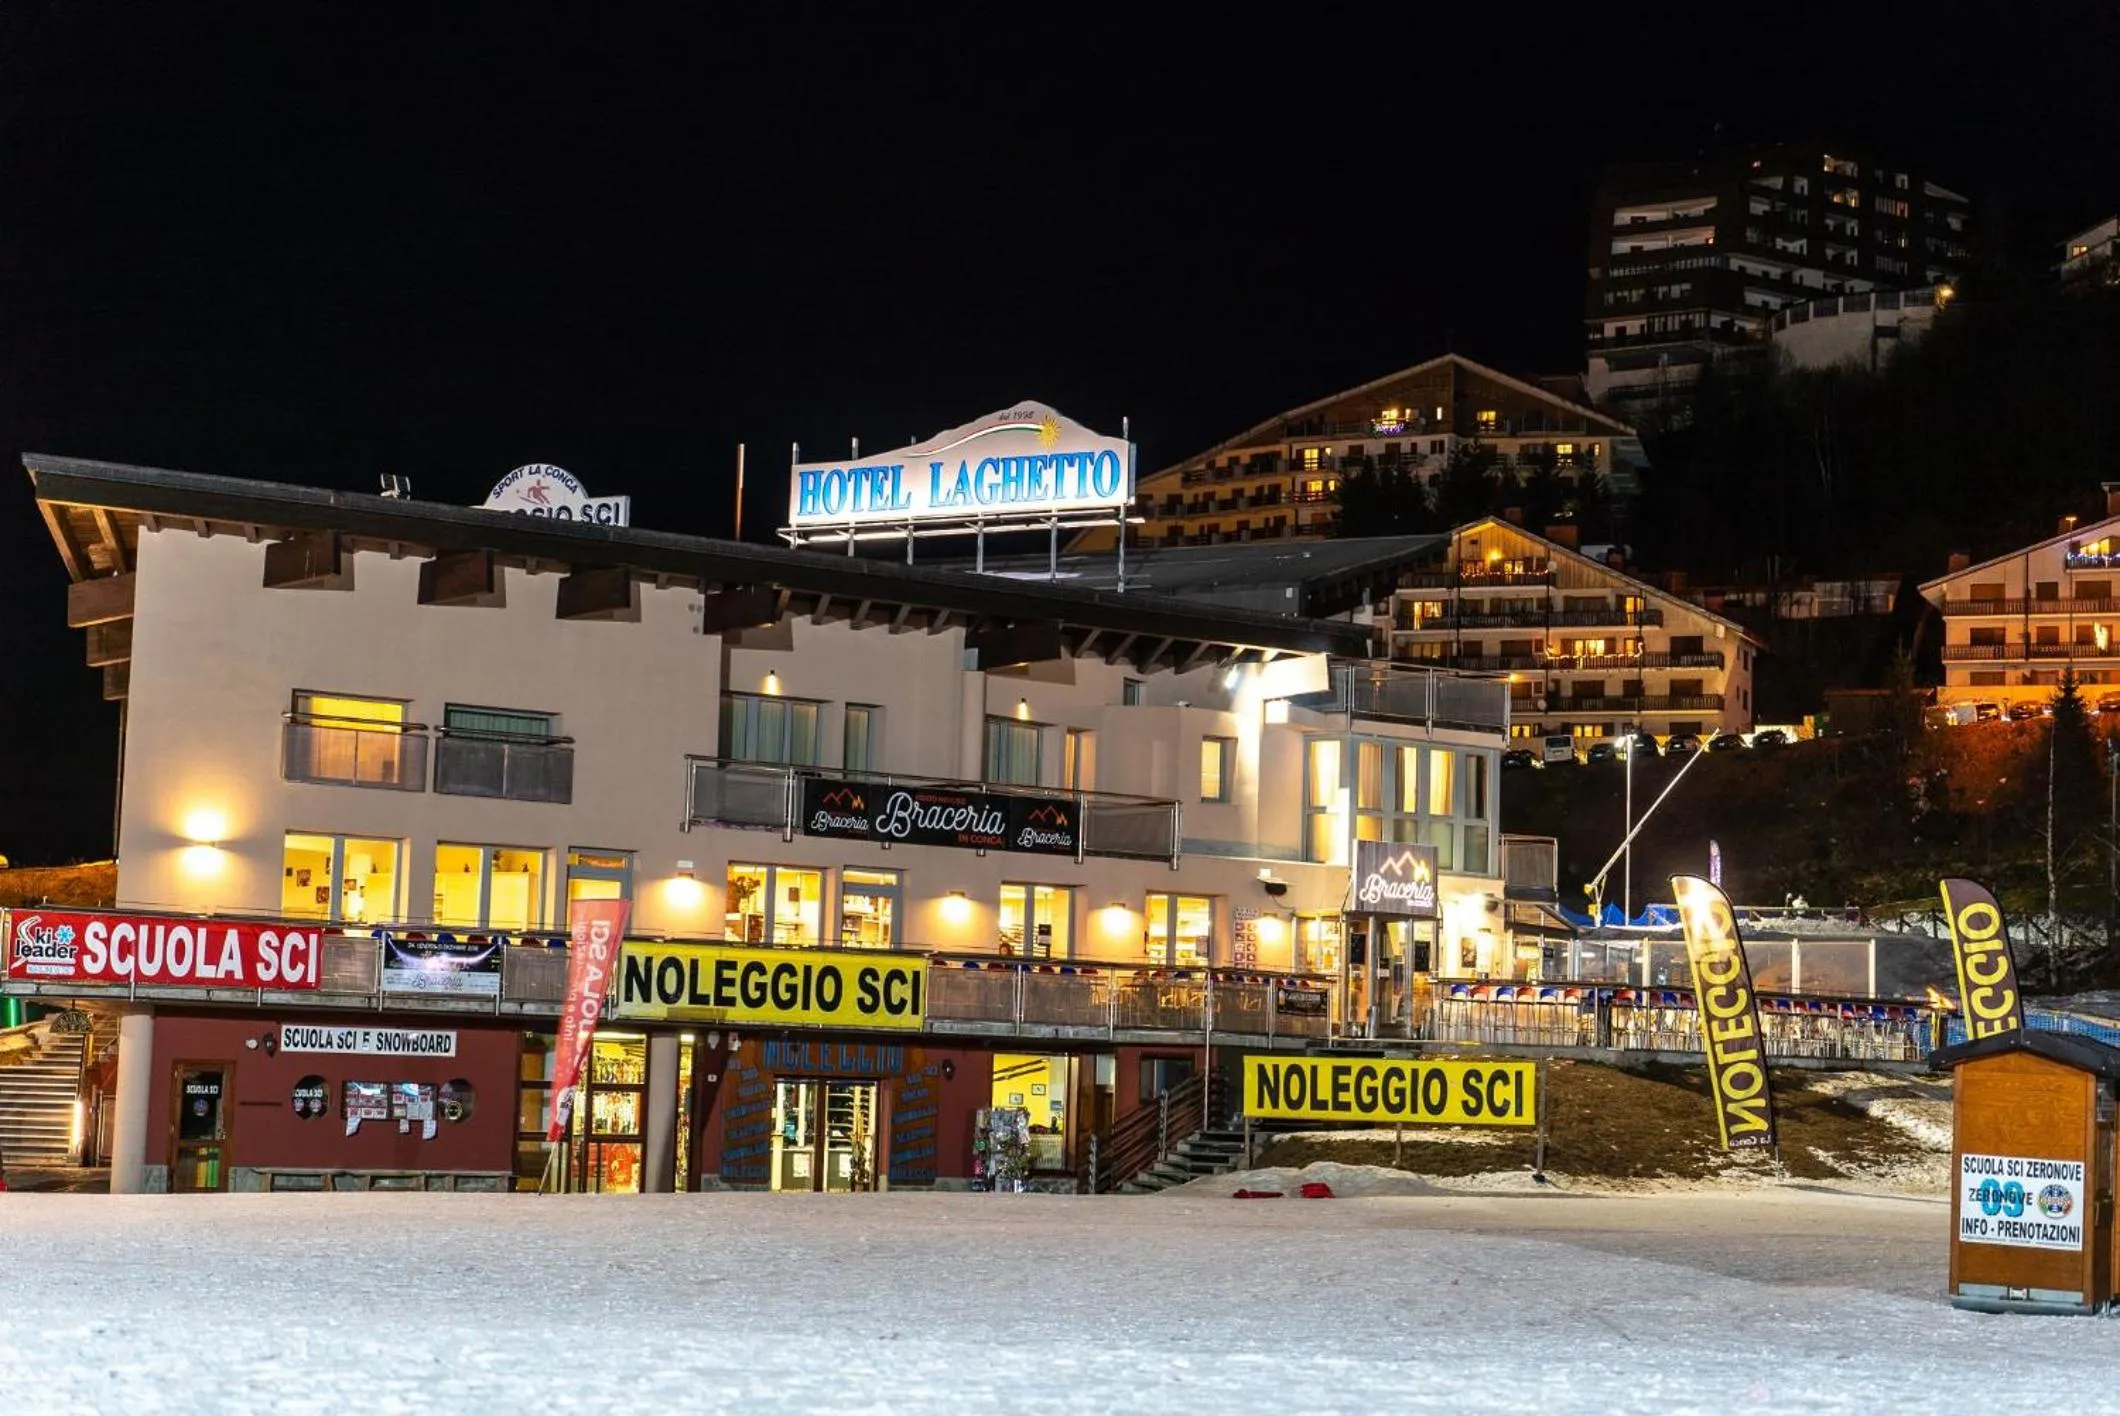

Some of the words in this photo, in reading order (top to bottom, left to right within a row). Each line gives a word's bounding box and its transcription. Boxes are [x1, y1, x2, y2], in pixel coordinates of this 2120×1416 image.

[492, 467, 525, 499] SPORT
[529, 465, 541, 476] LA
[545, 465, 579, 495] CONCA
[797, 464, 912, 516] HOTEL
[929, 449, 1121, 508] LAGHETTO
[810, 810, 869, 831] Braceria
[875, 792, 1006, 838] Braceria
[1017, 827, 1072, 848] Braceria
[1359, 873, 1434, 904] Braceria
[15, 938, 77, 959] leader
[83, 921, 244, 980] SCUOLA
[256, 930, 318, 983] SCI
[624, 955, 843, 1012] NOLEGGIO
[857, 967, 920, 1016] SCI
[284, 1028, 333, 1049] SCUOLA
[337, 1031, 357, 1050] SCI
[376, 1032, 452, 1054] SNOWBOARD
[1256, 1063, 1448, 1116] NOLEGGIO
[1461, 1068, 1523, 1118] SCI
[1963, 1156, 2005, 1176] SCUOLA
[2006, 1159, 2024, 1177] SCI
[2026, 1161, 2082, 1182] ZERONOVE
[1968, 1187, 2034, 1206] ZERONOVE
[1961, 1217, 1989, 1236] INFO
[1997, 1220, 2080, 1243] PRENOTAZIONI
